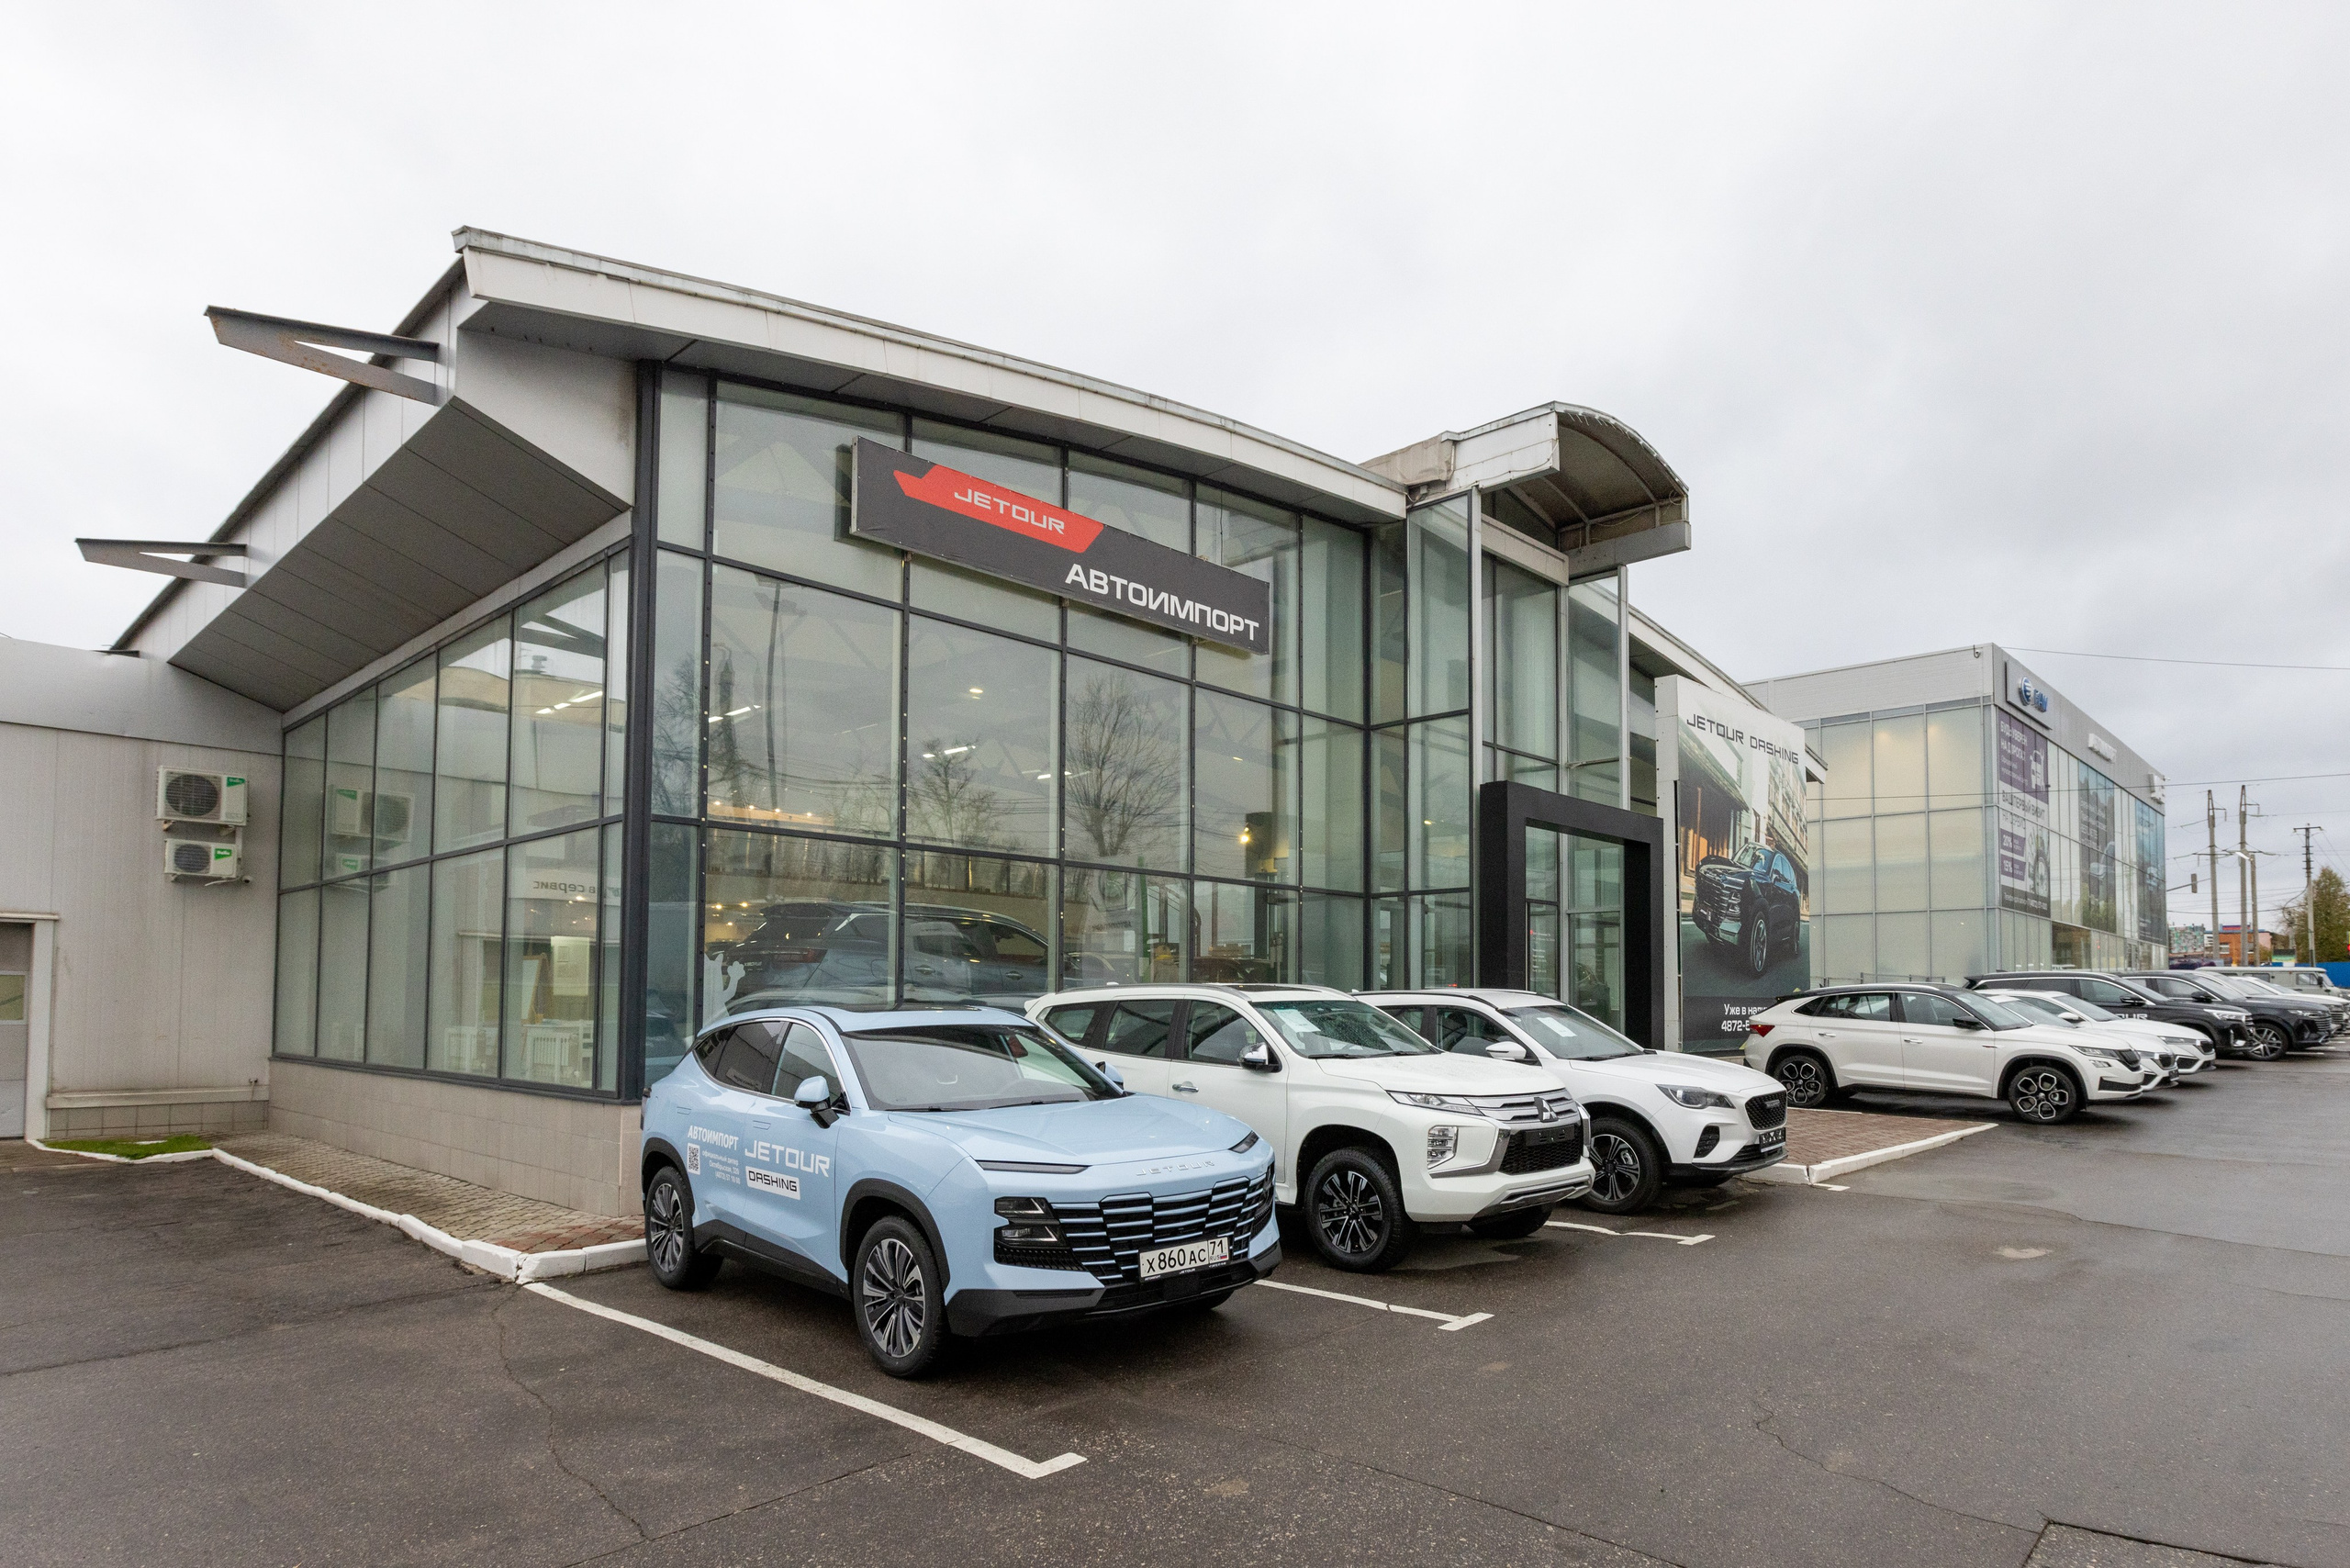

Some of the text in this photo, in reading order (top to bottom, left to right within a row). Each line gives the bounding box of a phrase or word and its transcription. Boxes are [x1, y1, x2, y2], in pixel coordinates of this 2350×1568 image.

[954, 488, 1065, 535] JETOUR
[1065, 563, 1259, 641] АВТОИМПОРТ
[1686, 713, 1799, 766] JETOUR DASHING
[1724, 1003, 1740, 1015] Уже
[1741, 1006, 1747, 1015] в
[688, 1125, 739, 1150] АВТОИМПОРТ
[744, 1139, 831, 1177] JETOUR
[1136, 1160, 1215, 1176] JETOUR
[748, 1170, 798, 1192] DASHING
[1210, 1239, 1224, 1255] 71
